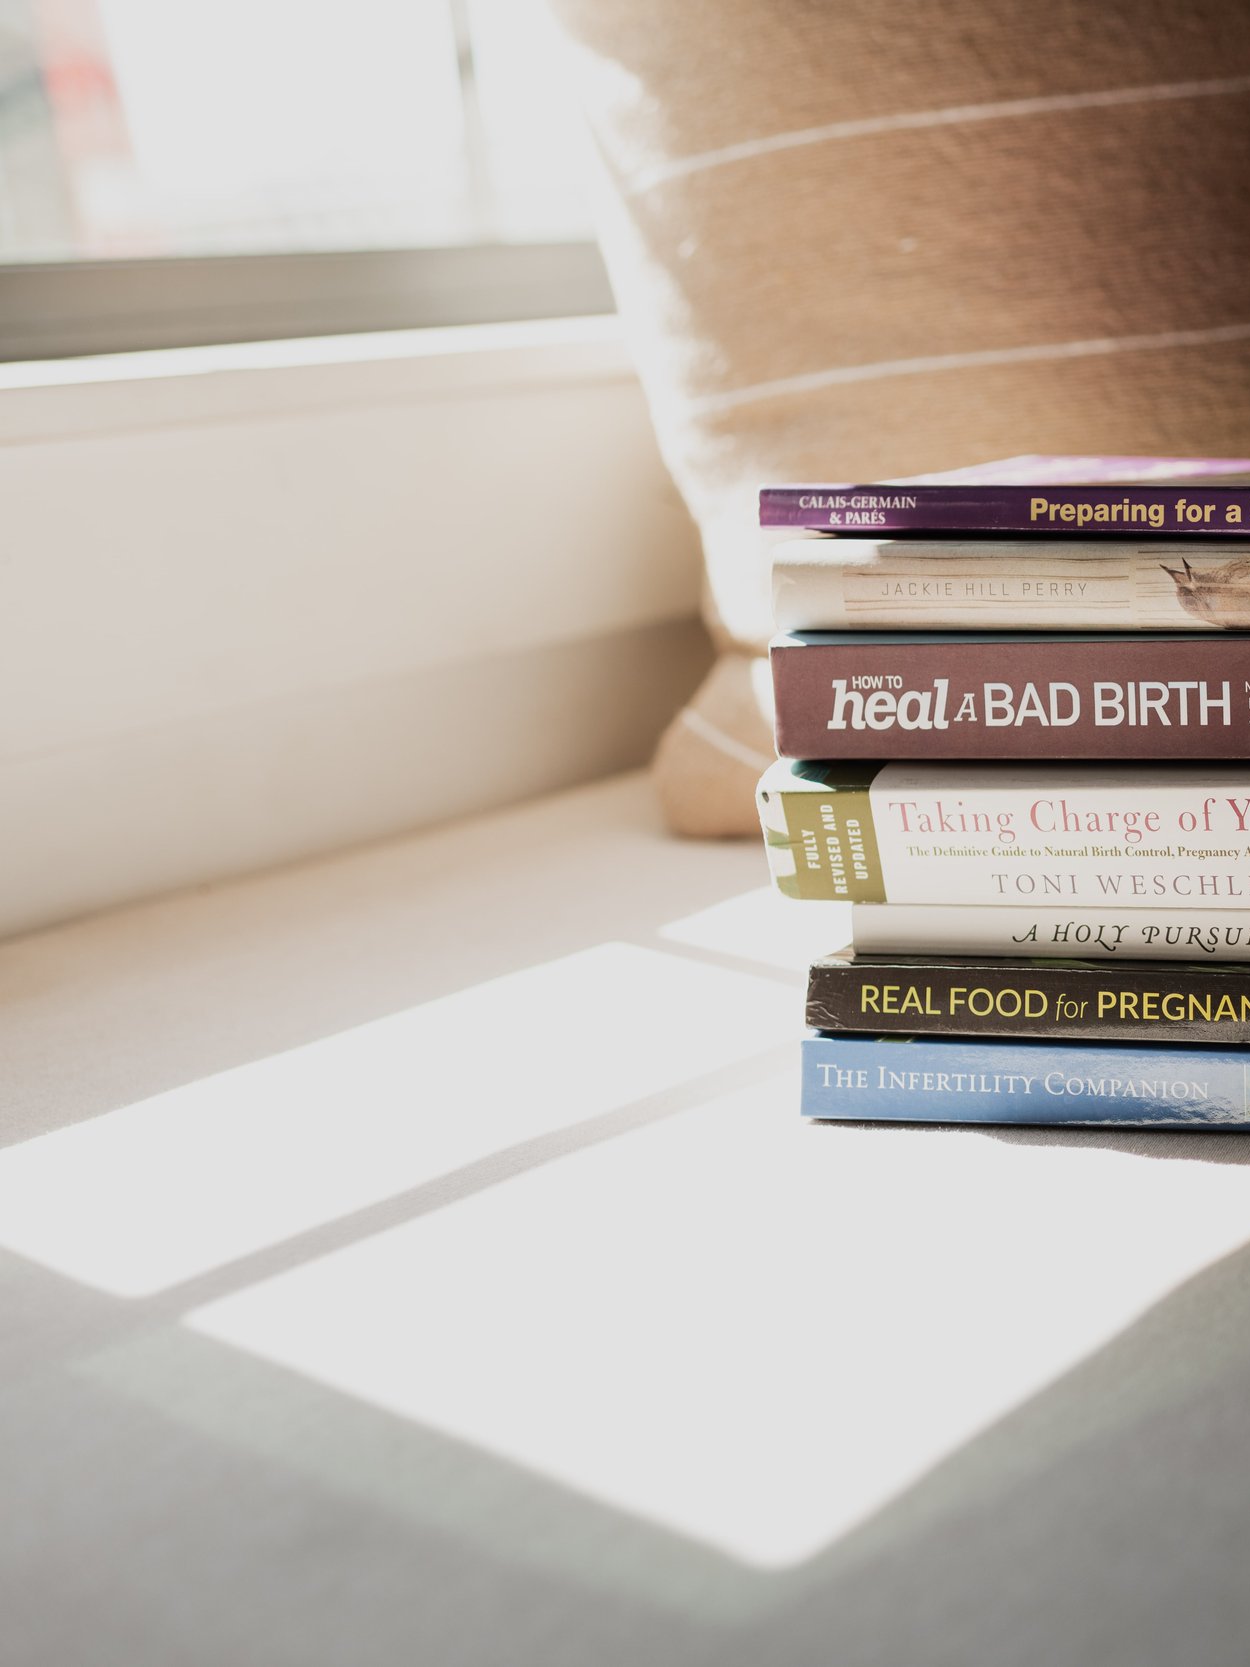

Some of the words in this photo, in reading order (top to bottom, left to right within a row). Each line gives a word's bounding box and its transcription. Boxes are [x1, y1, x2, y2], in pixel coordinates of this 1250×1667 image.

[799, 496, 917, 509] CALAIS-GERMAIN
[829, 512, 842, 525] &
[845, 509, 886, 525] PARÉS
[1030, 497, 1164, 527] Preparing
[1175, 498, 1215, 523] for
[1226, 504, 1241, 523] a
[881, 582, 953, 597] JACKIE
[965, 582, 1010, 596] HILL
[1022, 582, 1088, 597] PERRY
[852, 676, 883, 689] HOW
[885, 675, 902, 689] TO
[827, 679, 949, 730] heal
[953, 693, 978, 722] A
[983, 682, 1081, 727] BAD
[1093, 681, 1231, 726] BIRTH
[820, 805, 837, 831] AND
[889, 801, 1016, 843] Taking
[1030, 800, 1160, 843] Charge
[1178, 798, 1216, 832] of
[801, 829, 821, 869] FULLY
[846, 820, 868, 879] UPDATED
[906, 846, 930, 857] The
[934, 847, 988, 857] Definitive
[992, 847, 1027, 857] Guide
[1030, 847, 1041, 857] to
[1045, 846, 1088, 857] Natural
[1092, 846, 1121, 857] Birth
[1125, 846, 1175, 859] Control,
[1178, 846, 1240, 860] Pregnancy
[826, 837, 848, 894] REVISED
[991, 874, 1079, 894] TONI
[1012, 924, 1038, 943] A
[1051, 922, 1130, 951] HOLY
[861, 985, 941, 1015] REAL
[949, 987, 1048, 1018] FOOD
[1055, 993, 1089, 1021] for
